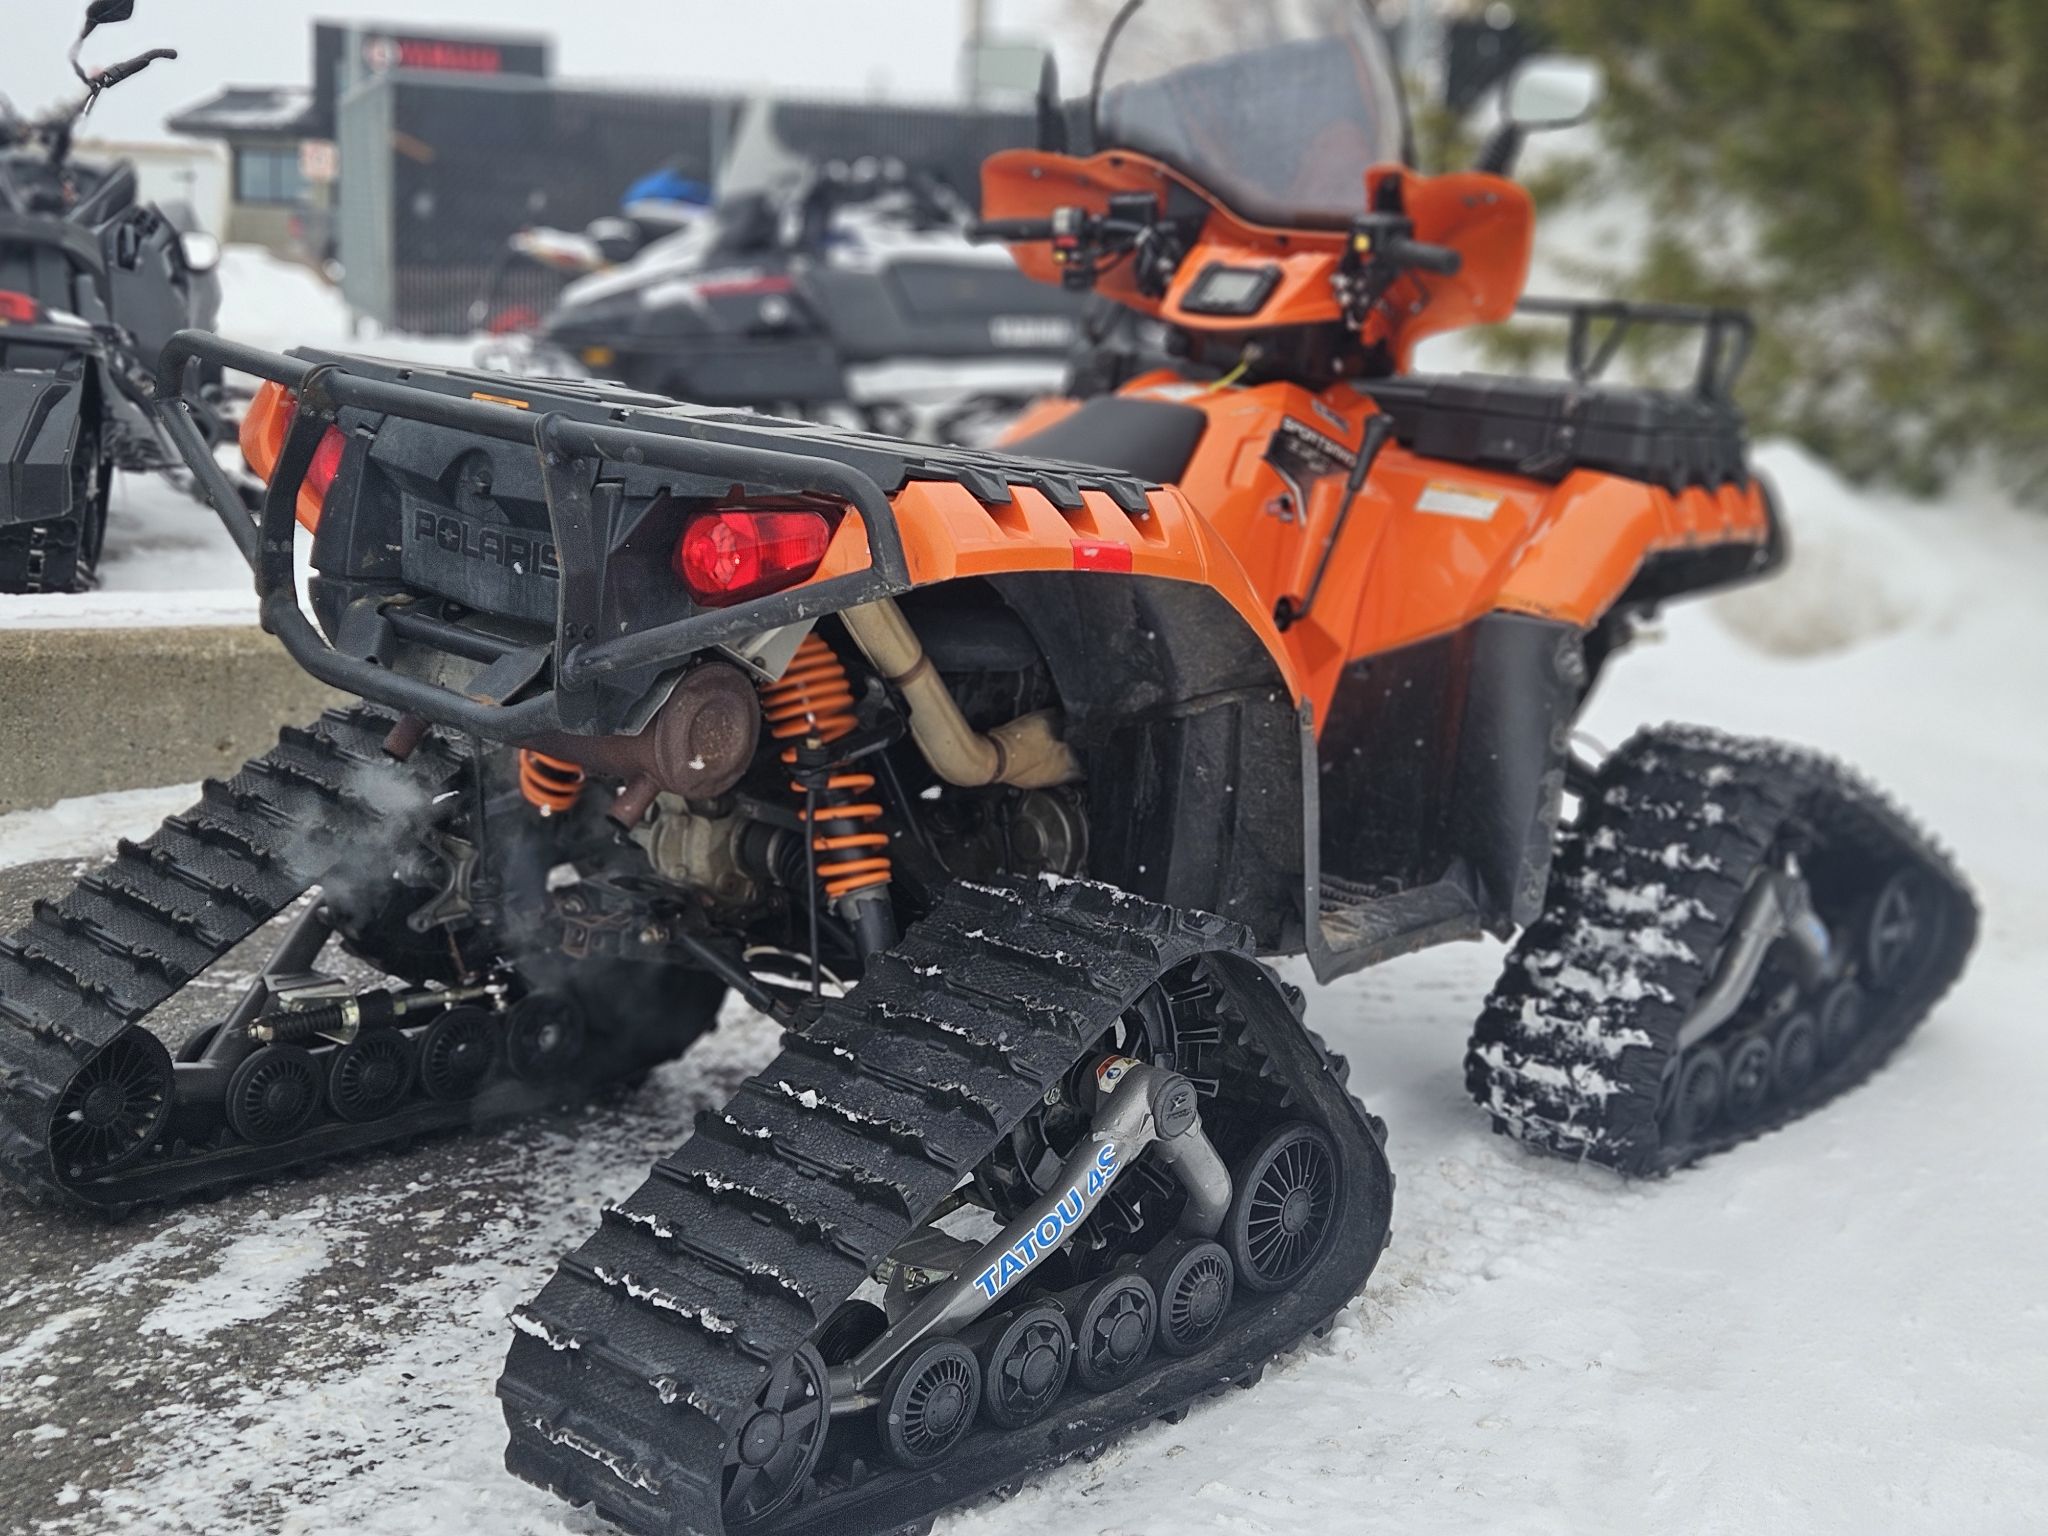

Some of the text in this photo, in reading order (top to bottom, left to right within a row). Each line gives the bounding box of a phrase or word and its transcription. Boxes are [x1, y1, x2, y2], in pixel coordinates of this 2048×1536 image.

[414, 508, 560, 580] POLARIS
[974, 1143, 1121, 1300] TATOU 4S
